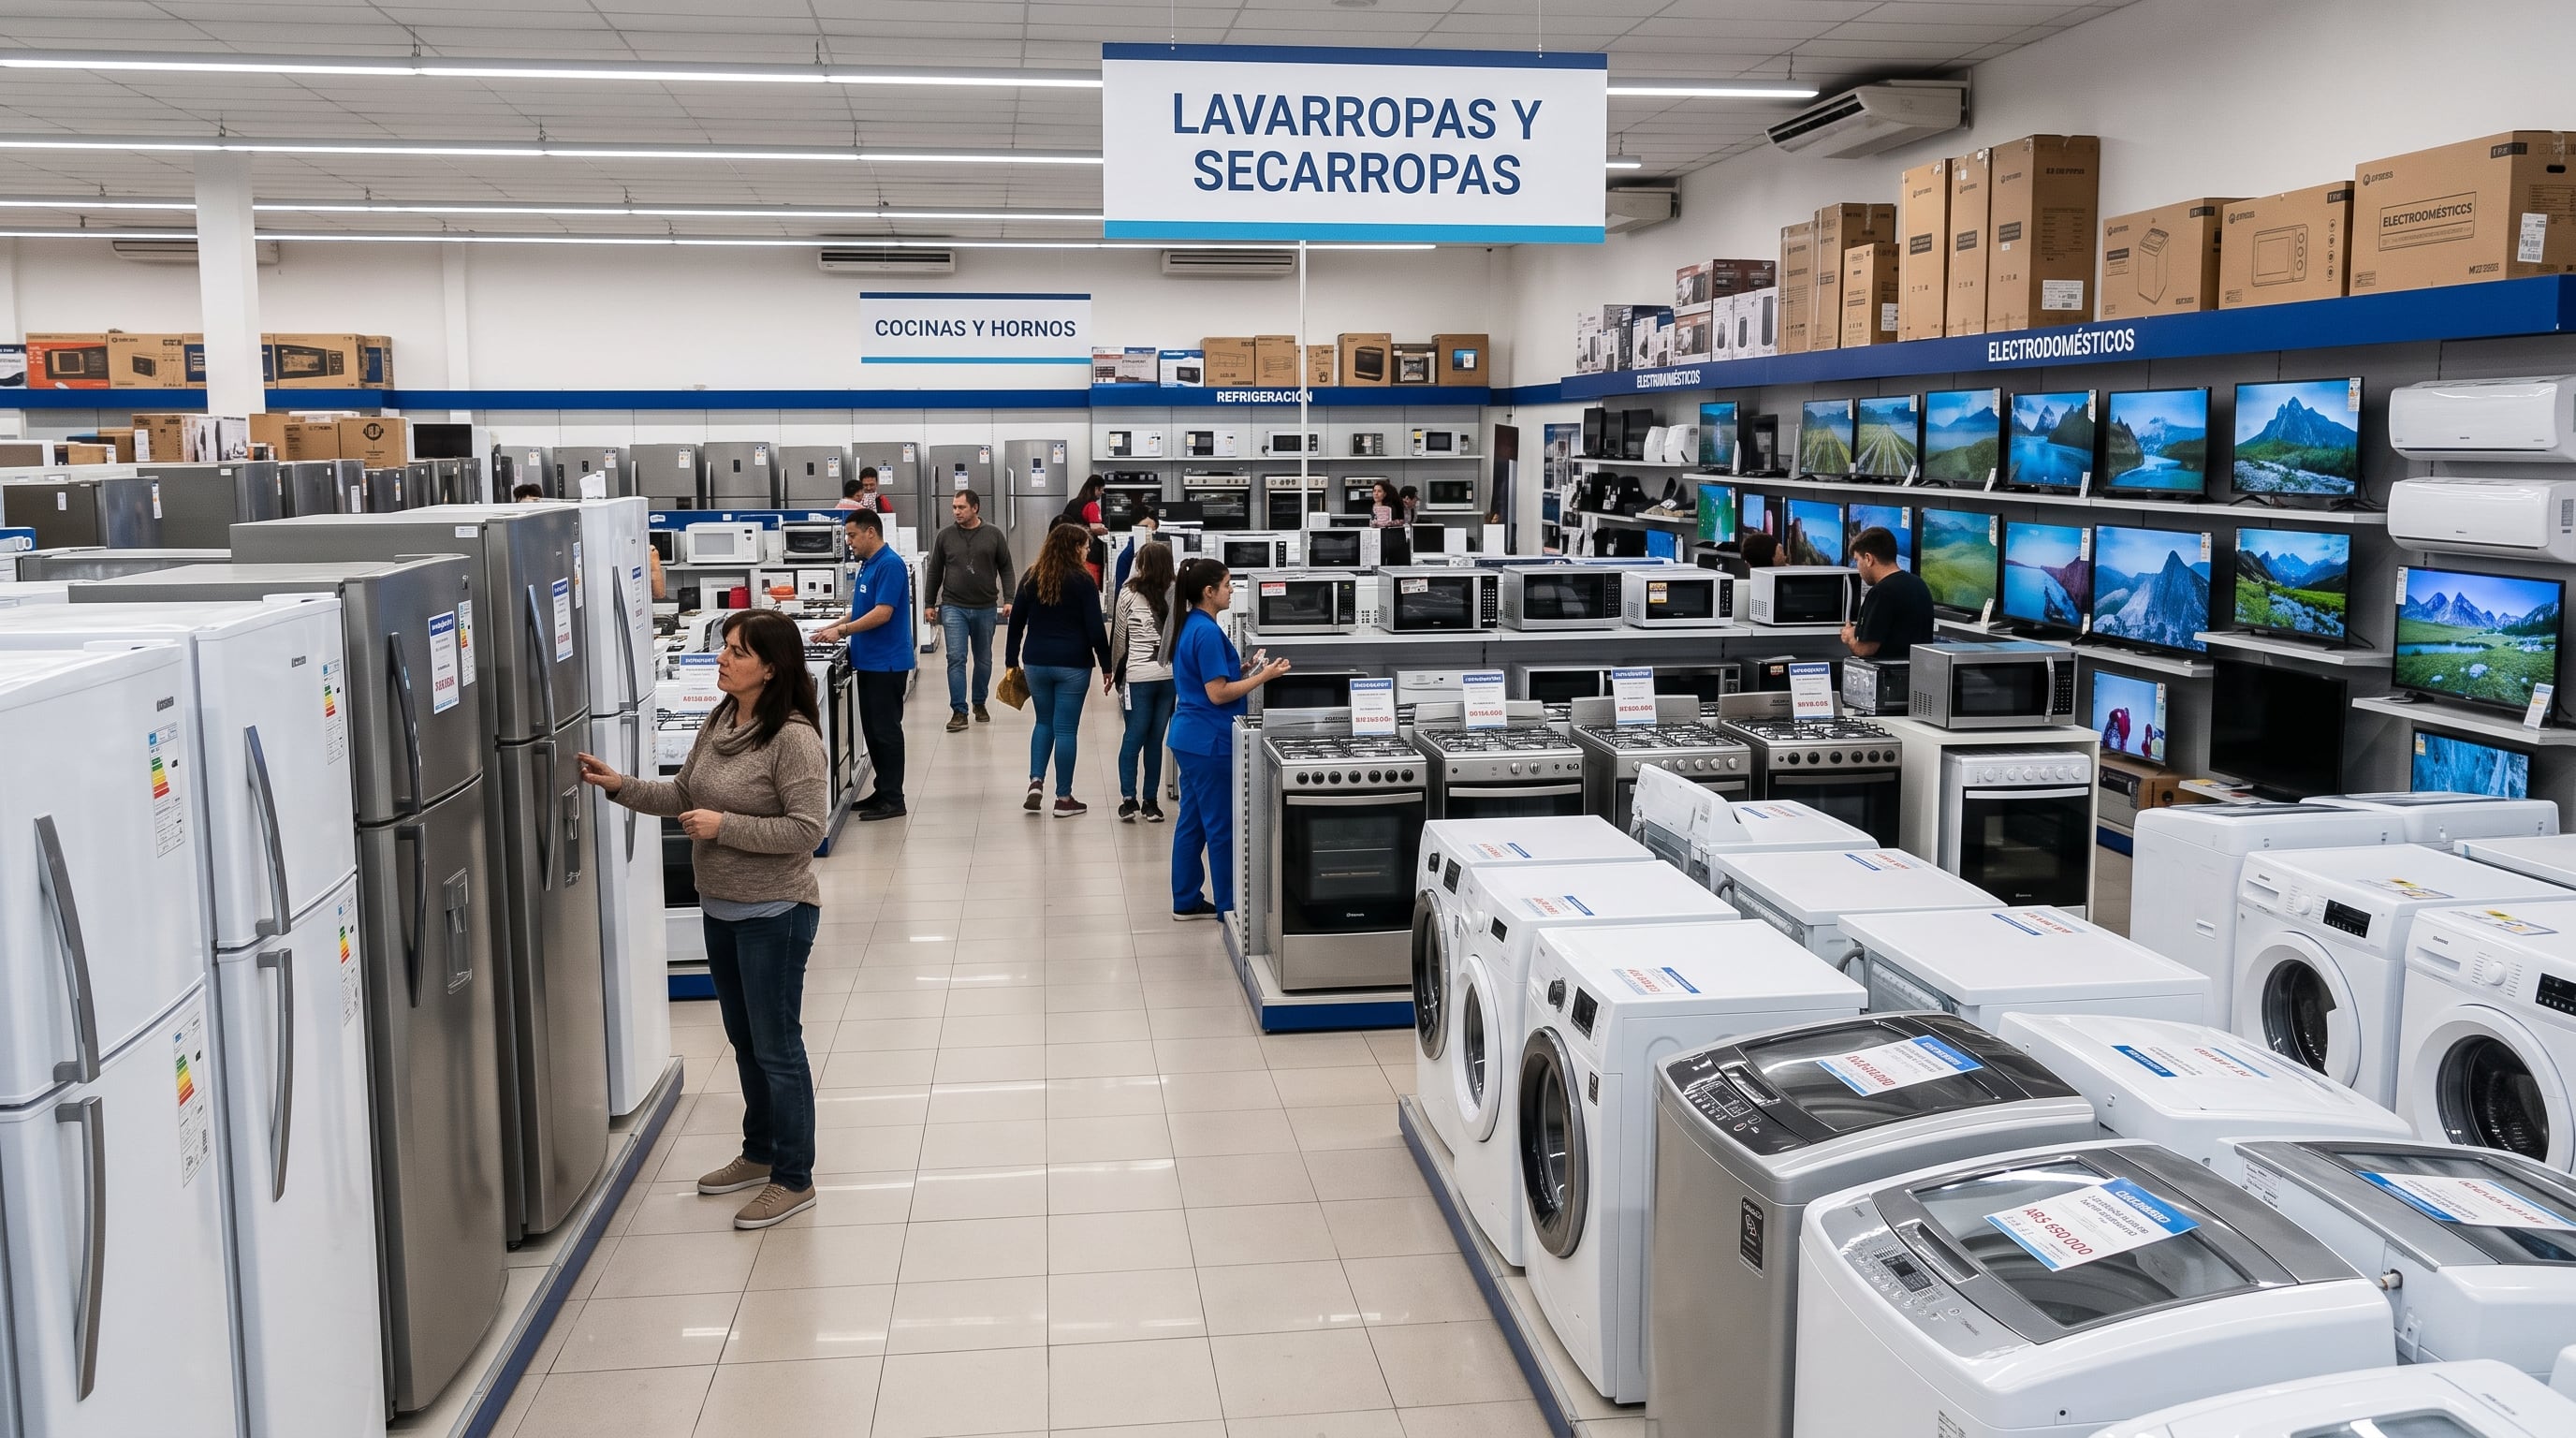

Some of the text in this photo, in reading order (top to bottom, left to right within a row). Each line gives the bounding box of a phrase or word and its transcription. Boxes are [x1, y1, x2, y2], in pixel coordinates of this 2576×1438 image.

[1173, 92, 1543, 140] LAVARROPAS Y
[1193, 149, 1521, 196] SECARROPAS
[875, 319, 1076, 337] COCINAS Y HORNOS
[1988, 328, 2135, 362] ELECTRODOMÉSTICOS
